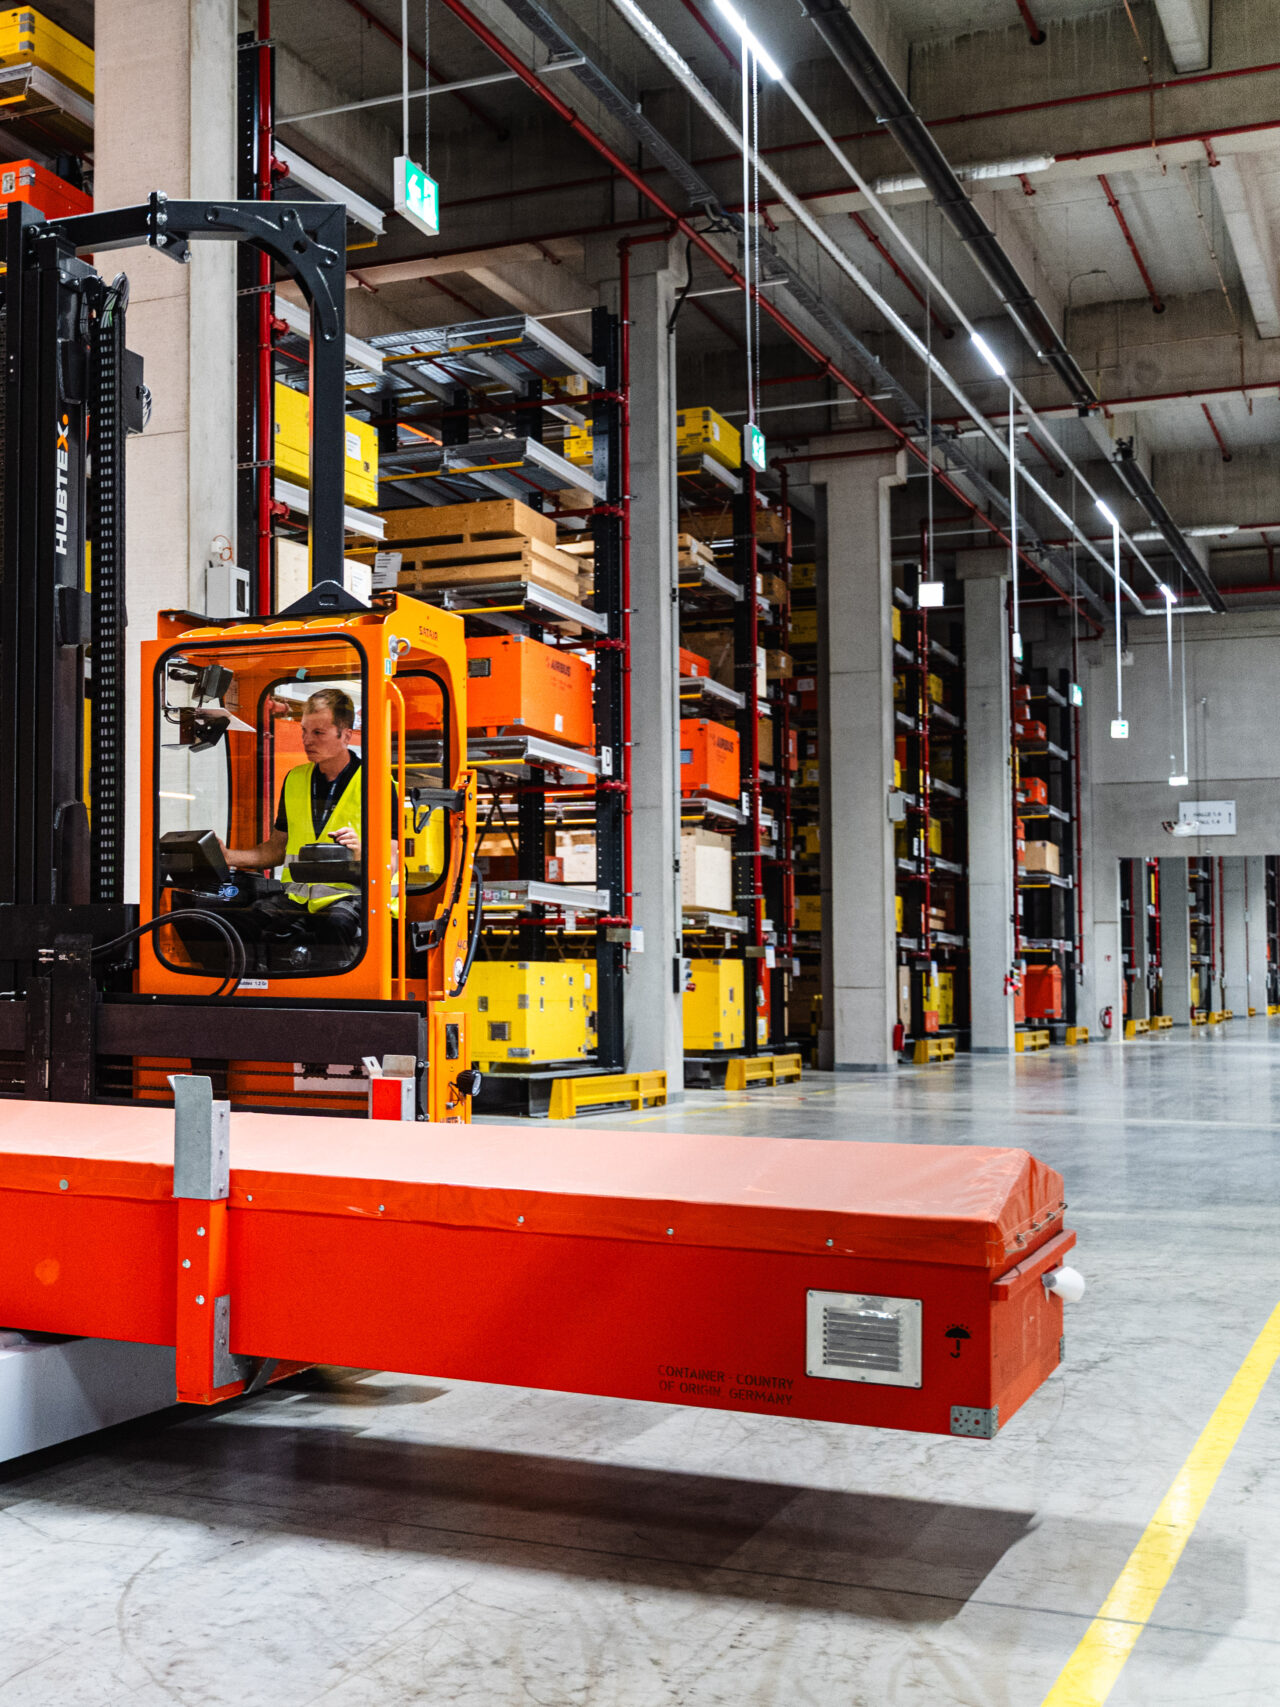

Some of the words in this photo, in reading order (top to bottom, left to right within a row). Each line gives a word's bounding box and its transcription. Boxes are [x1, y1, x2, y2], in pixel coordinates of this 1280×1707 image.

[55, 418, 69, 555] HUBTEX
[657, 1364, 726, 1383] CONTAINER
[736, 1373, 795, 1391] COUNTRY
[658, 1379, 676, 1392] OF
[679, 1382, 721, 1398] ORIGIN
[729, 1387, 793, 1406] GERMANY
